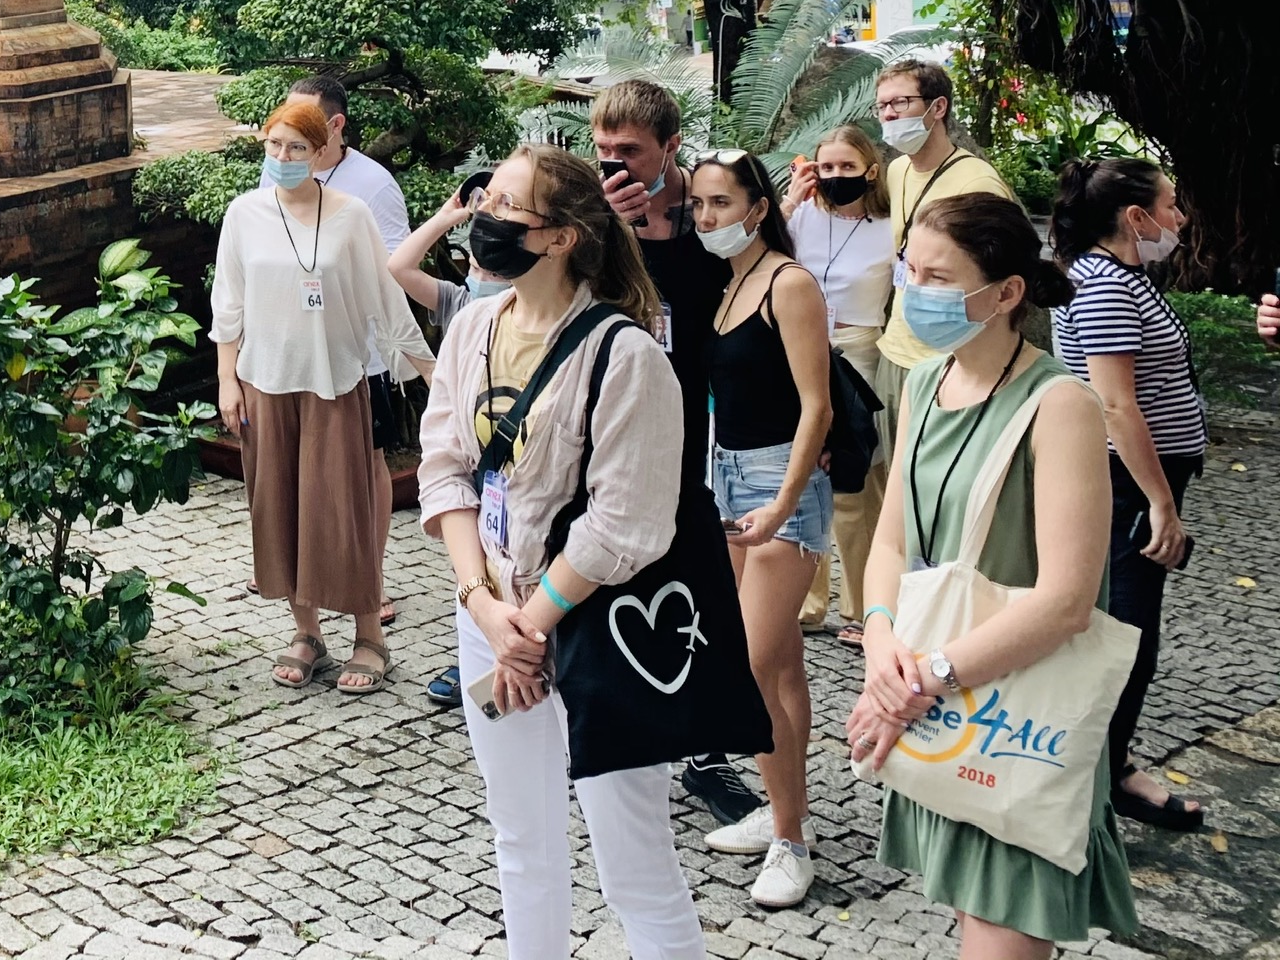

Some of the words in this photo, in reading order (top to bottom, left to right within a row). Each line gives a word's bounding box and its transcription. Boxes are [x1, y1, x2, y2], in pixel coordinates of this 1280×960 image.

[308, 294, 322, 307] 64
[485, 487, 502, 503] anex
[486, 512, 498, 535] 64
[957, 765, 996, 788] 2018
